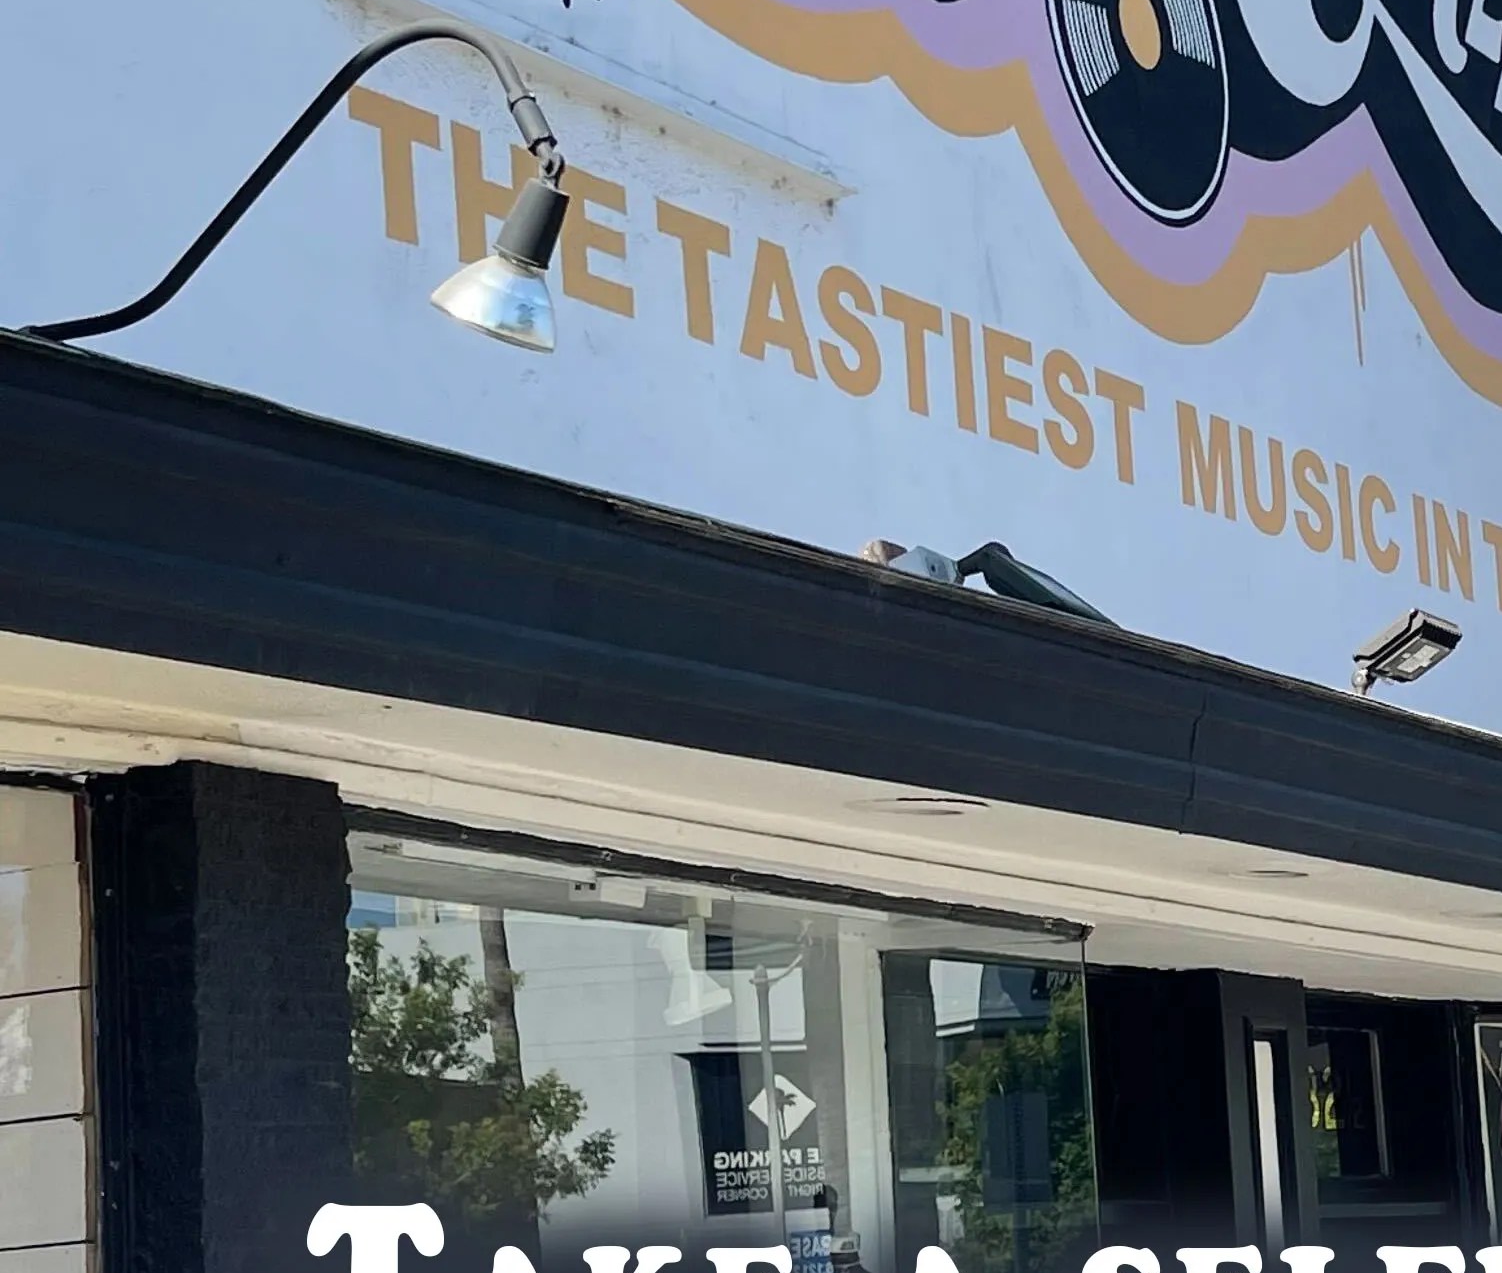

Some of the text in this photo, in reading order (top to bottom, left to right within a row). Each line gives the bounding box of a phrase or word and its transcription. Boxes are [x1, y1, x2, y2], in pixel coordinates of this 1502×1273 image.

[348, 84, 635, 319] THE
[655, 195, 1146, 485] TASTIEST
[1175, 399, 1401, 574] MUSIC
[1411, 492, 1475, 602] IN
